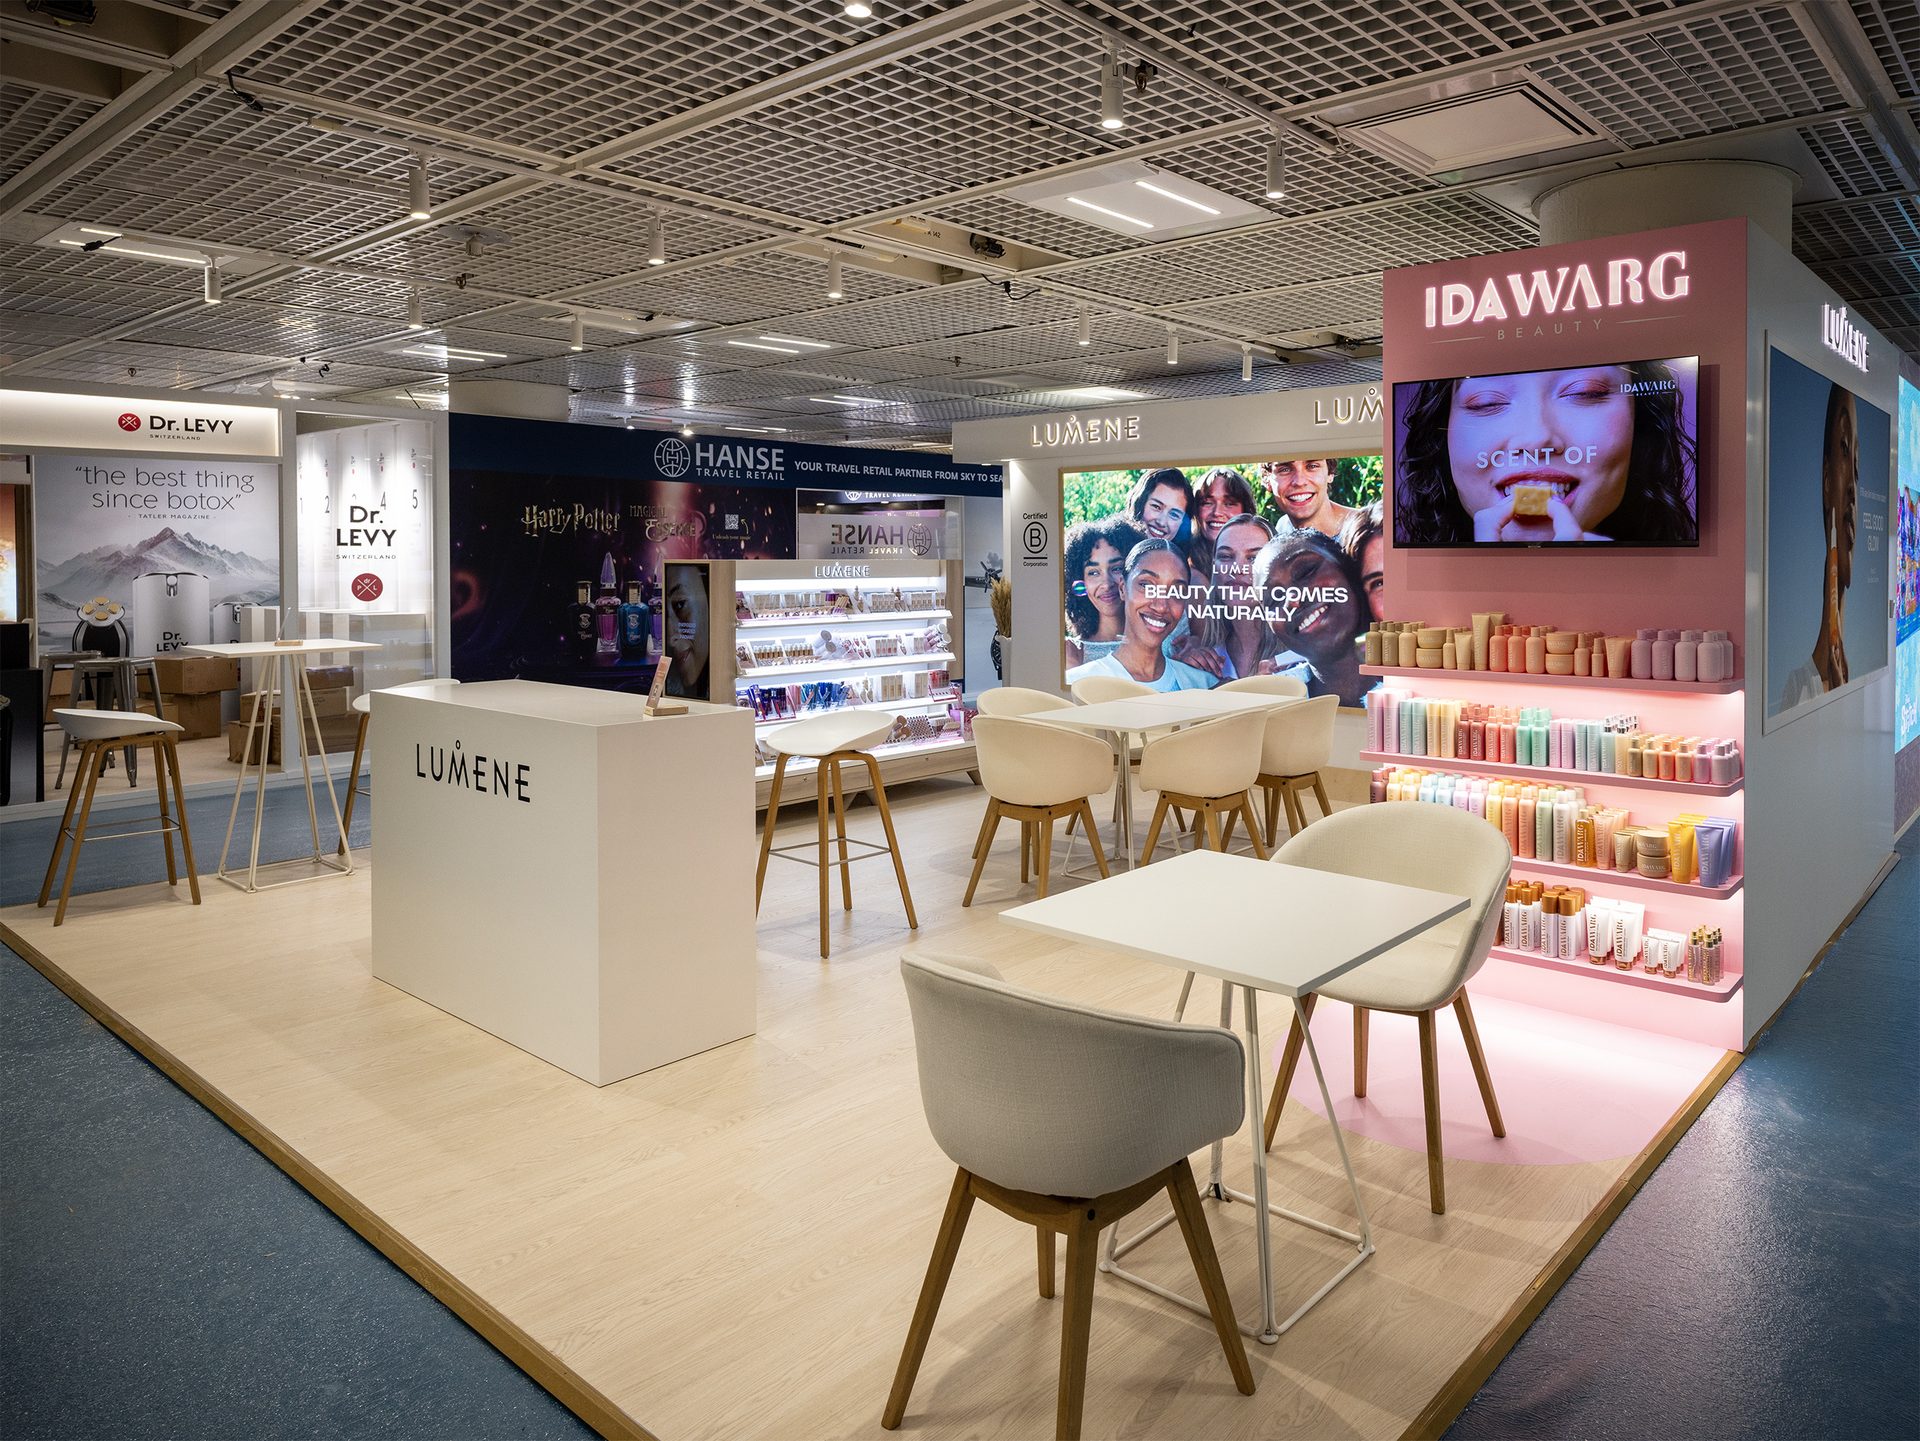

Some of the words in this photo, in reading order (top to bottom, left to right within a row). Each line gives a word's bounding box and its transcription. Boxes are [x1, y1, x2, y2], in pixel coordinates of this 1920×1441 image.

[1424, 250, 1690, 328] IDAWARG
[1497, 319, 1603, 341] BEAUTY
[1821, 303, 1870, 373] LUMENE
[1620, 380, 1676, 393] IDAWARG
[149, 415, 180, 431] Dr.
[184, 417, 234, 434] LEVY
[1031, 415, 1141, 447] LUMENE
[695, 442, 785, 471] HANSE
[1476, 447, 1555, 469] SCENT
[1564, 445, 1598, 465] OF
[135, 467, 187, 488] best
[194, 470, 255, 494] thing
[696, 467, 741, 479] TRAVEL
[746, 471, 785, 481] RETAIL
[794, 461, 823, 472] YOUR
[825, 463, 861, 475] TRAVEL
[863, 465, 893, 477] RETAIL
[895, 468, 933, 479] PARTNER
[934, 470, 959, 481] FROM
[960, 473, 976, 482] SKY
[977, 474, 988, 482] TO
[92, 490, 158, 509] since
[324, 495, 331, 514] 2
[380, 491, 387, 511] 4
[412, 489, 419, 510] 5
[349, 505, 384, 524] Dr.
[521, 504, 572, 538] Harry
[572, 503, 622, 536] Potter
[1022, 512, 1048, 520] Certified
[336, 528, 397, 547] LEVY
[1030, 528, 1042, 548] B
[815, 561, 871, 578] LUMENE
[1212, 562, 1270, 575] LUMENE
[1144, 584, 1215, 600] BEAUTY
[1218, 585, 1268, 601] THAT
[1271, 586, 1349, 604] COMES
[1187, 604, 1298, 623] NATURALLY
[162, 632, 182, 641] Dr.
[416, 739, 531, 804] LUMENE
[1701, 833, 1710, 876] IDAWARG
[1520, 911, 1528, 947] IDAWARG
[1589, 914, 1597, 952] IDAWARG
